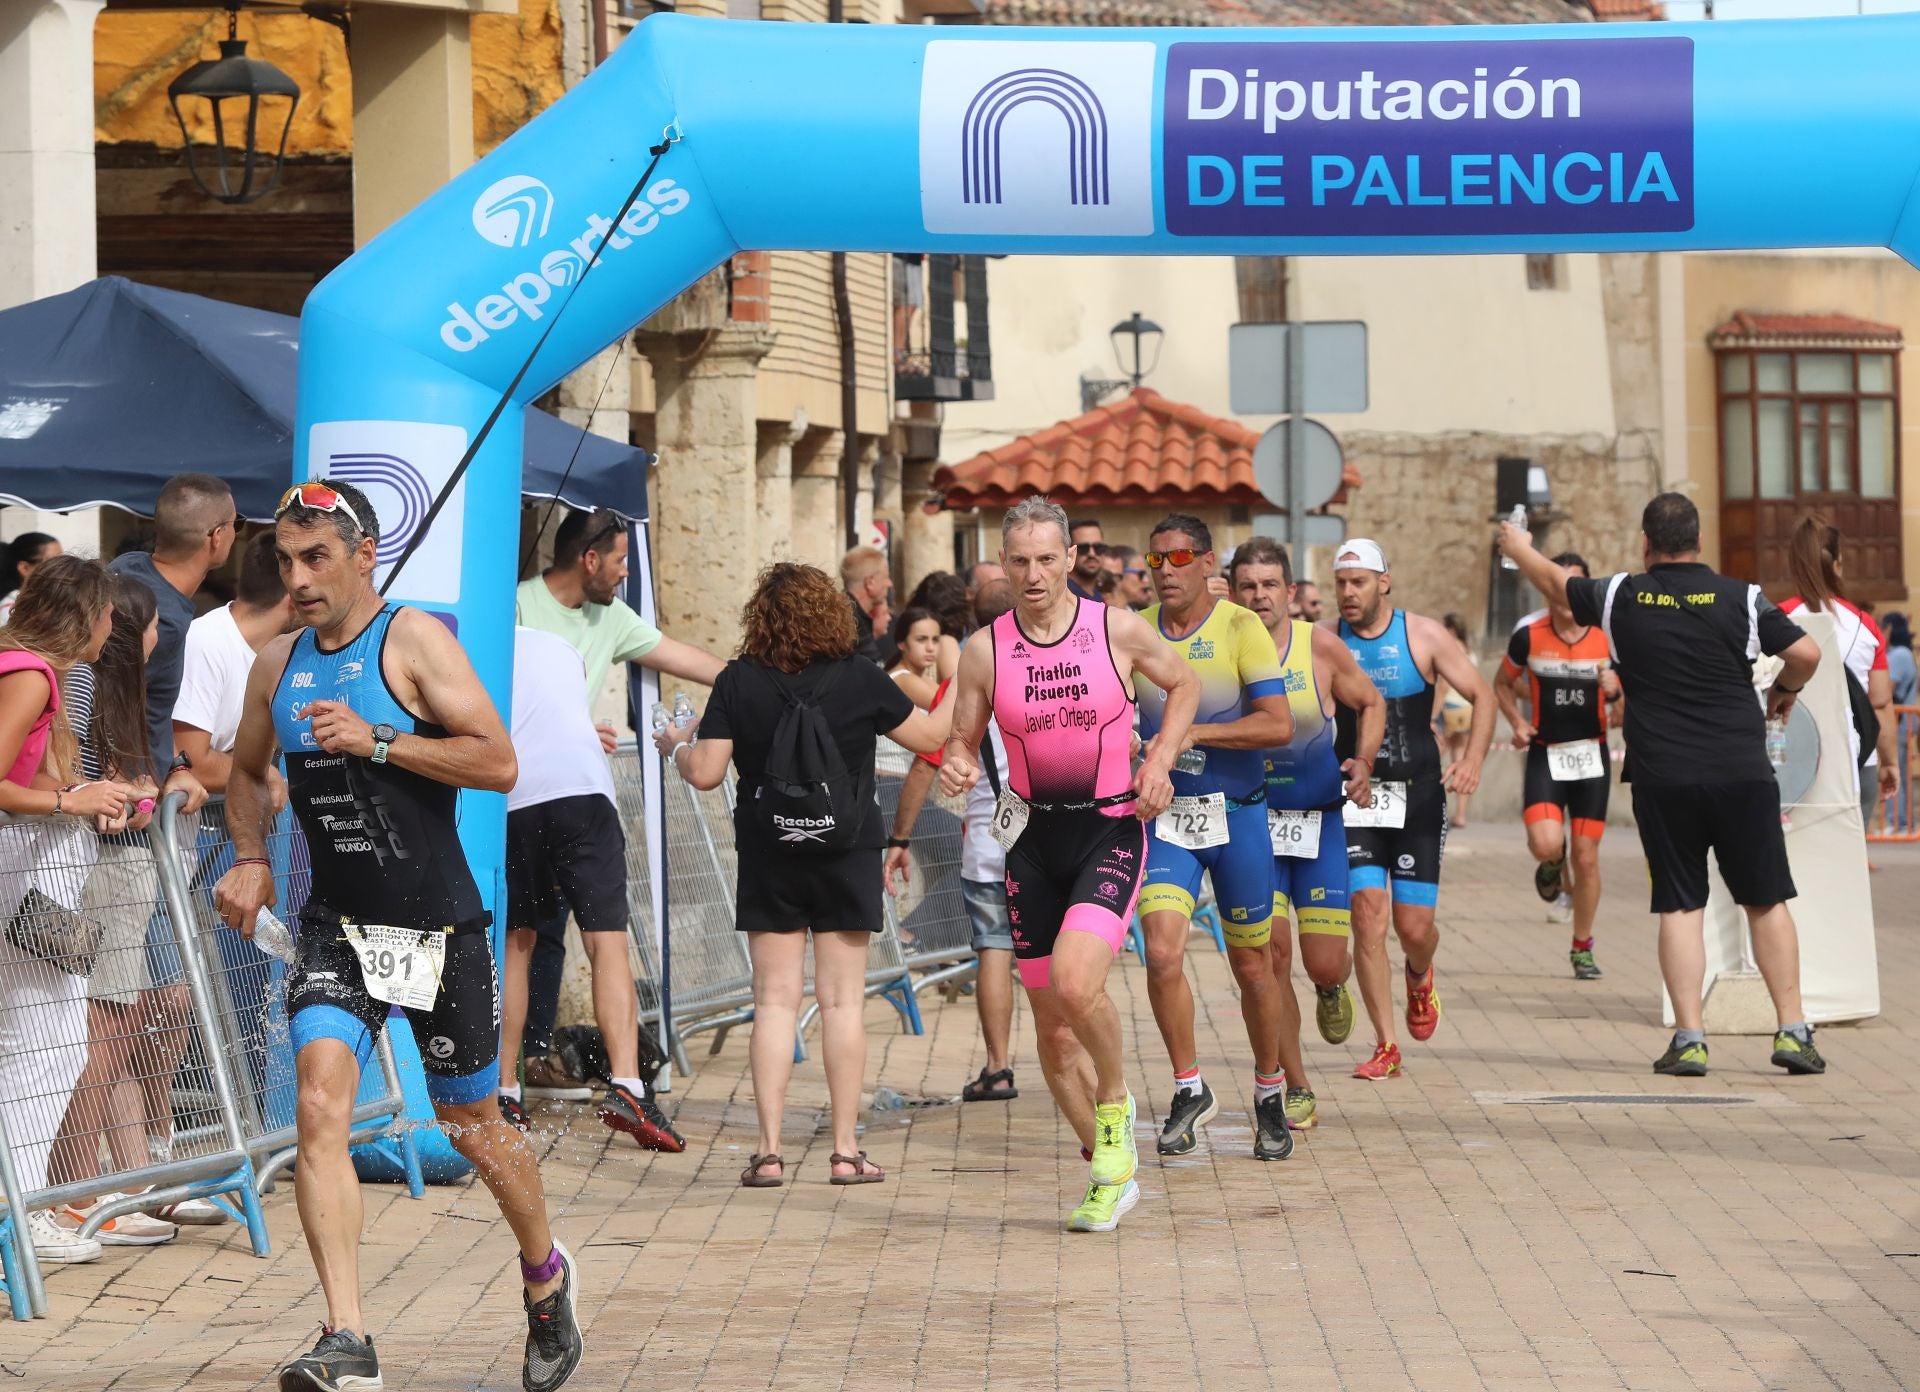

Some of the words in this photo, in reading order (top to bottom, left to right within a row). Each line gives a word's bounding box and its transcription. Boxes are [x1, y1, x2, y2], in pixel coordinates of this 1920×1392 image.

[1187, 67, 1582, 134] Diputación
[1186, 155, 1286, 207] DE
[1311, 151, 1681, 206] PALENCIA
[440, 178, 691, 352] deportes
[1188, 651, 1214, 660] DUERO
[1026, 662, 1082, 684] Triatlón
[1024, 683, 1089, 703] Pisuerga
[1554, 688, 1586, 706] BLAS
[1024, 710, 1056, 733] Javier
[1059, 706, 1097, 732] Ortega
[773, 814, 836, 827] Reebok
[1171, 812, 1210, 834] 722
[1268, 822, 1302, 843] 746
[334, 841, 372, 853] MUNDO
[362, 949, 413, 981] 391
